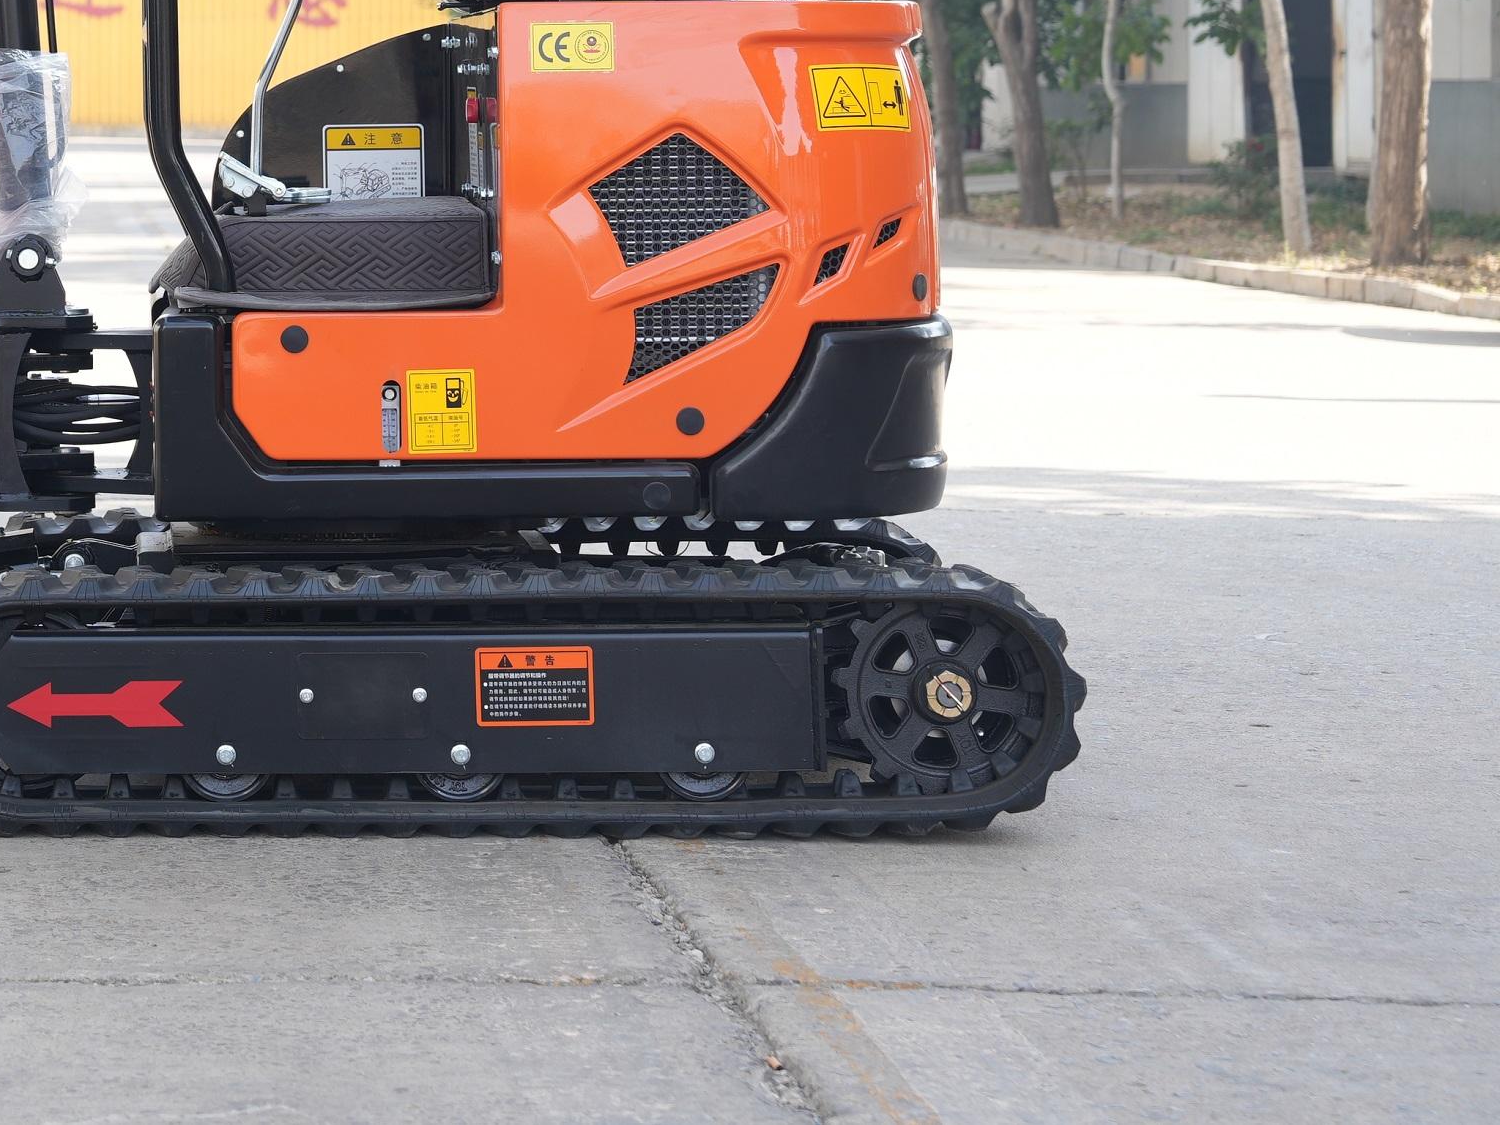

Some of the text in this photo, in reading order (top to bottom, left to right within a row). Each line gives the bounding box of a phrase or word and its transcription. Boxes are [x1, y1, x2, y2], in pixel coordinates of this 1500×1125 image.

[538, 31, 571, 63] CE
[364, 132, 403, 145] 注意
[525, 655, 555, 666] 警告
